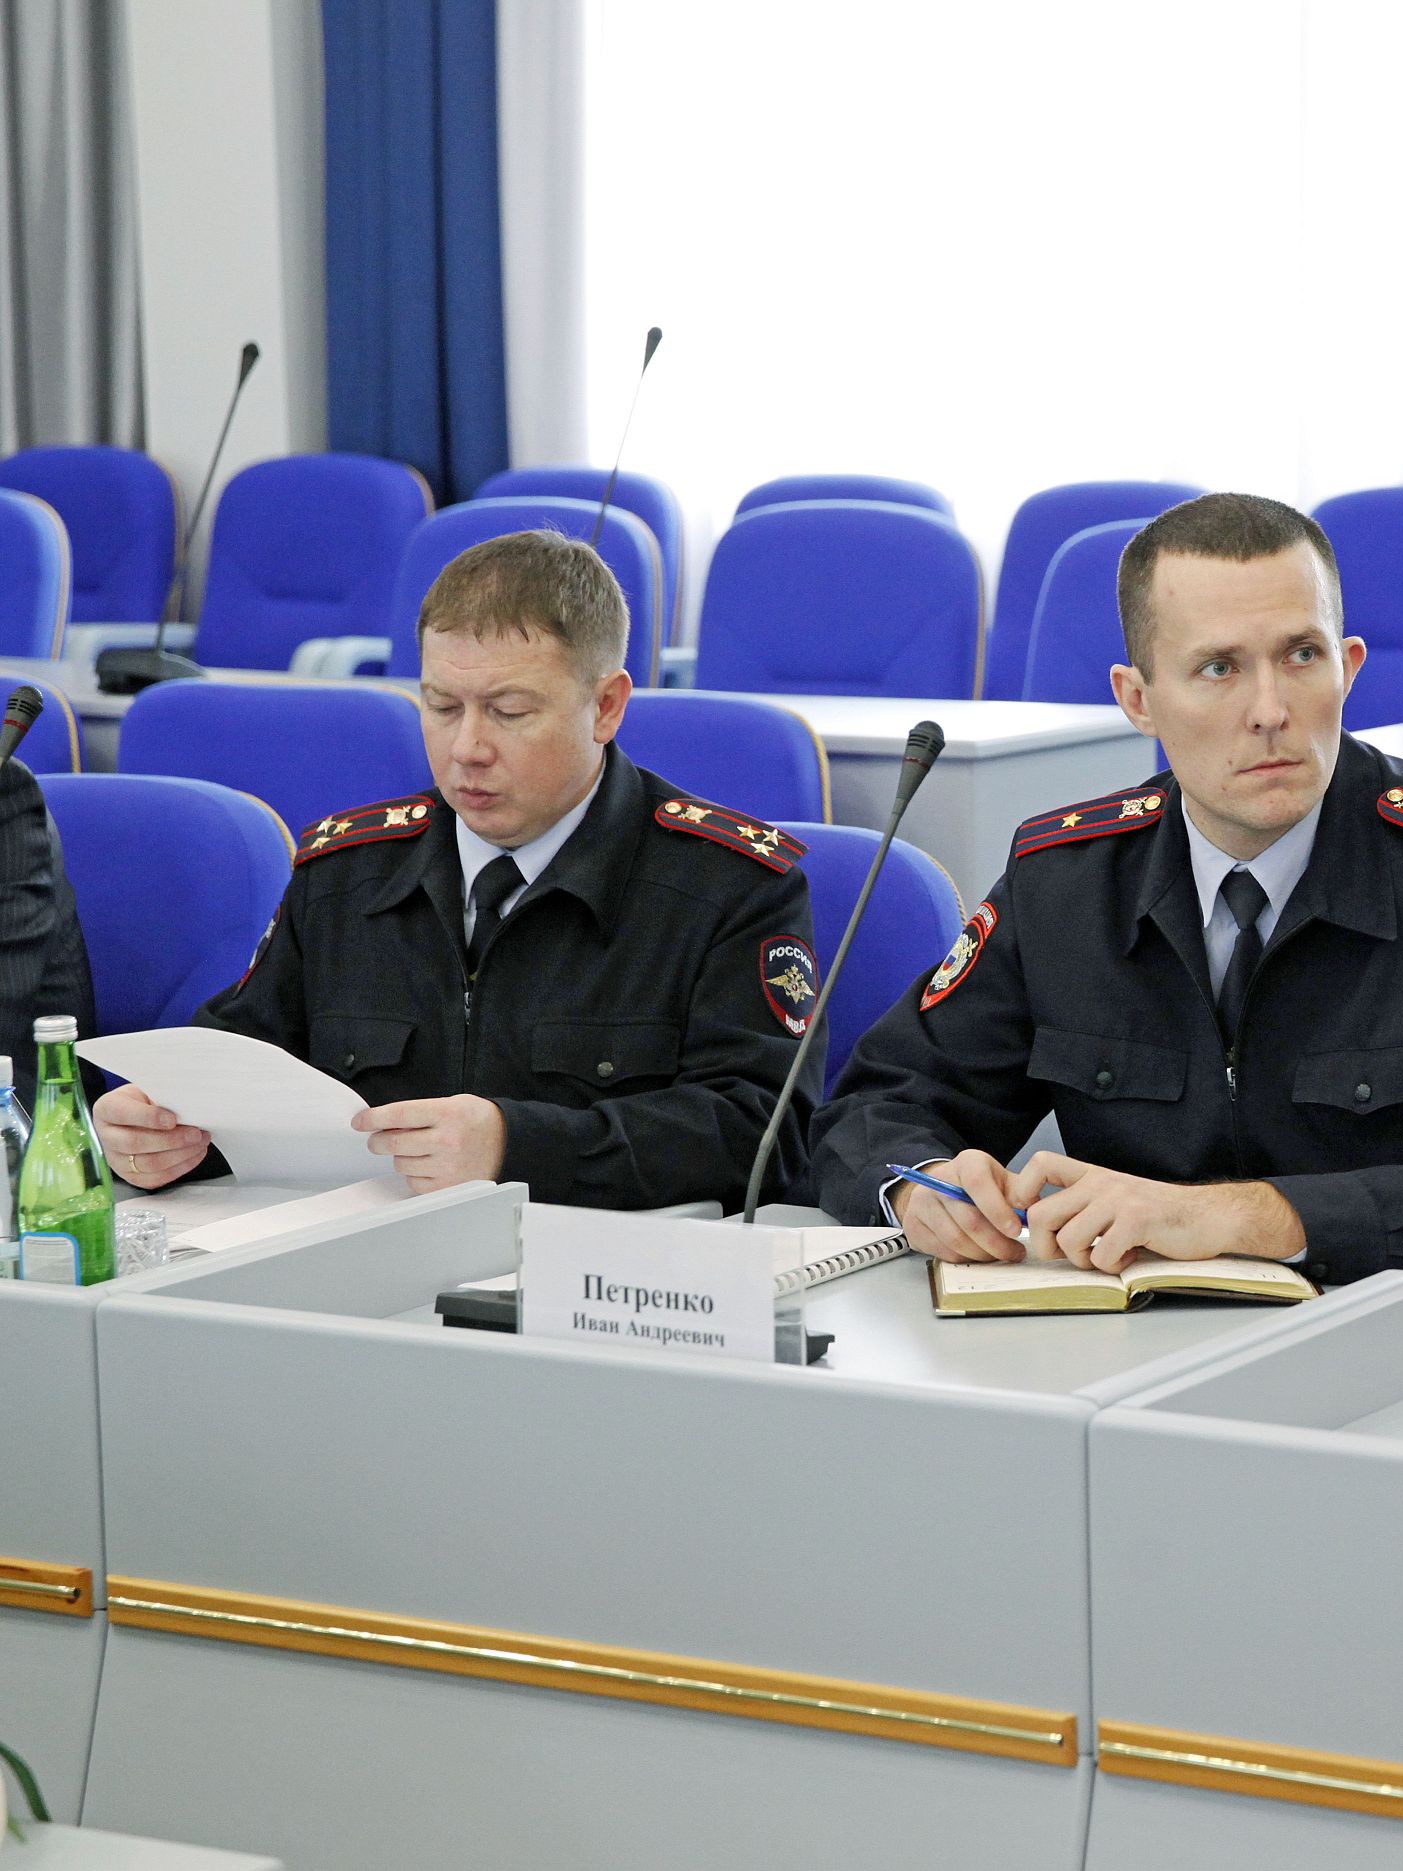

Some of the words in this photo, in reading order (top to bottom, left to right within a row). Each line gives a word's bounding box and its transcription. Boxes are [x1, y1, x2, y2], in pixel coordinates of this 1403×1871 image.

[769, 946, 812, 973] РОССИЯ
[583, 1273, 714, 1314] Петренко
[572, 1312, 619, 1334] Иван
[625, 1319, 725, 1348] Андреевич
